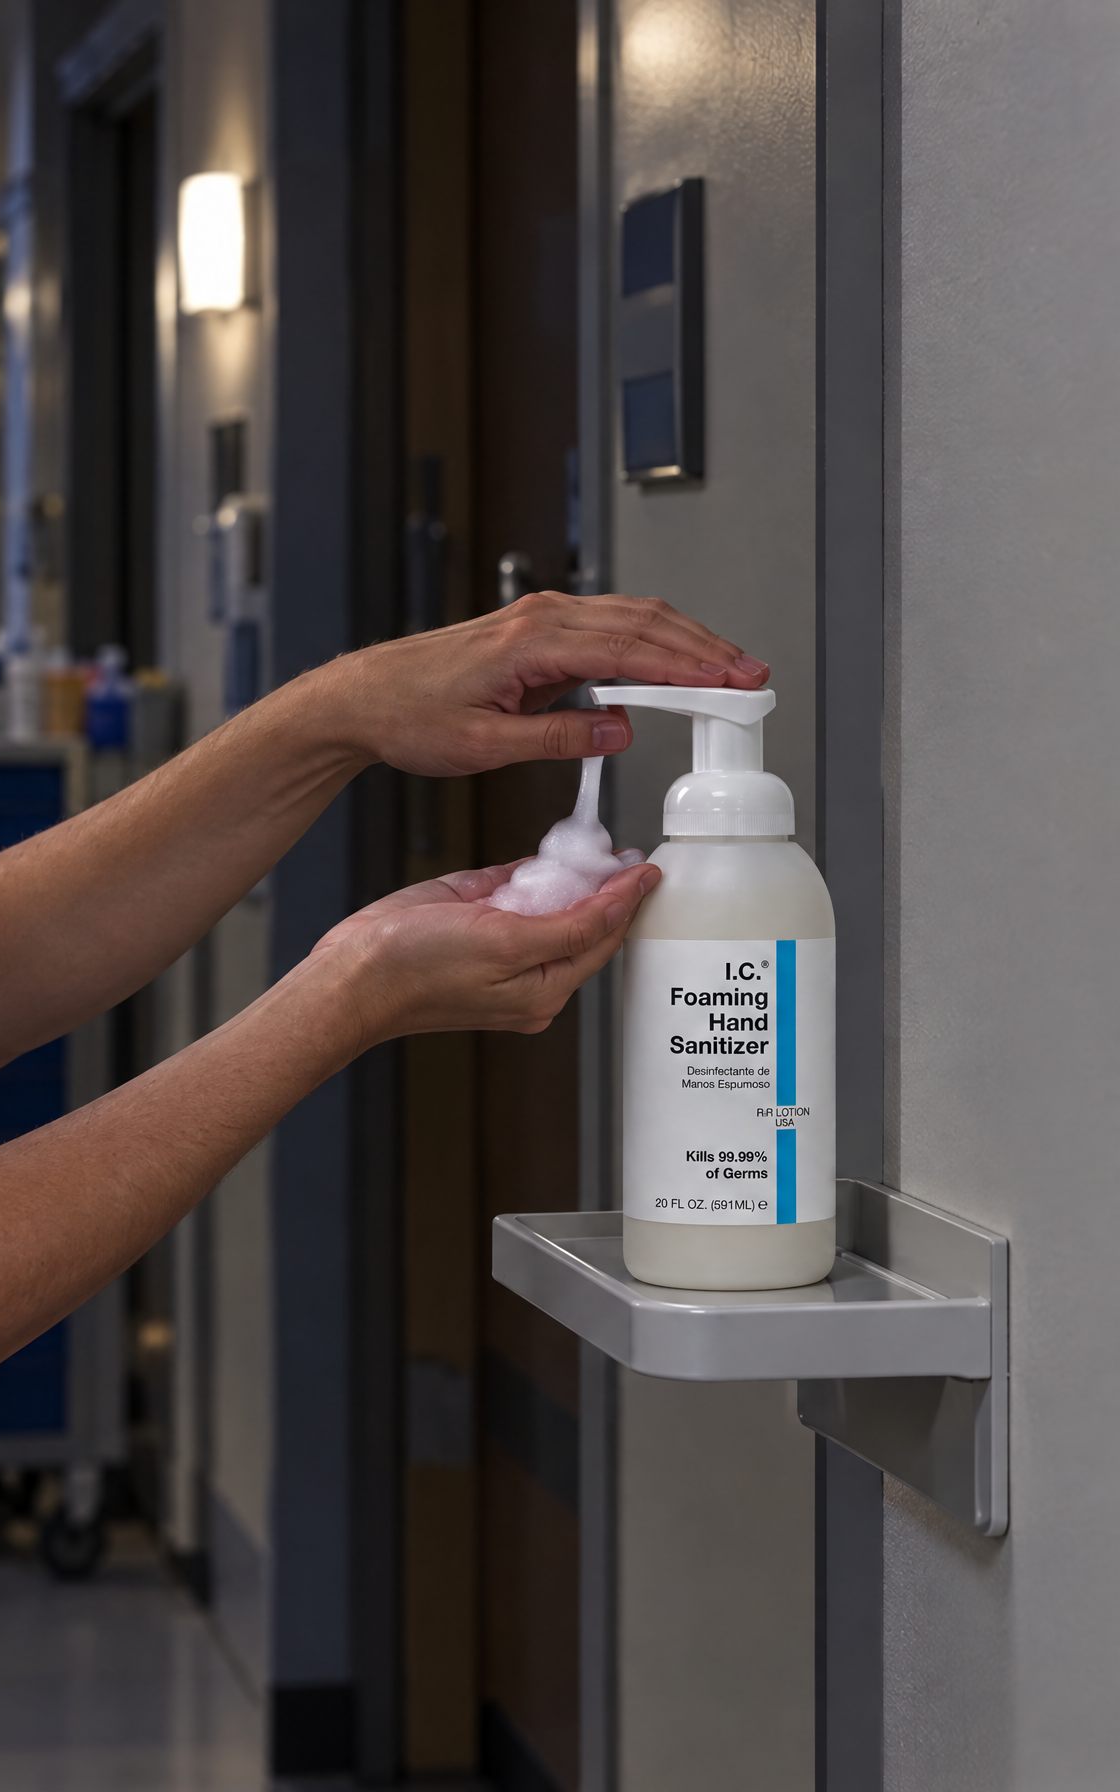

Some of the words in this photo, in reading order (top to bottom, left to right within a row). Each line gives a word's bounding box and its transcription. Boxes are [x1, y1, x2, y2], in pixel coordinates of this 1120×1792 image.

[671, 987, 768, 1010] Foaming
[709, 1013, 768, 1031] Hand
[670, 1035, 769, 1054] Sanitizer
[687, 1066, 754, 1076] Desinfectante
[758, 1066, 770, 1076] de
[682, 1079, 715, 1088] Manos
[718, 1080, 770, 1090] Espumoso
[776, 1107, 810, 1117] LOTION
[776, 1118, 794, 1127] USA
[686, 1151, 714, 1162] Kills
[719, 1151, 767, 1162] 99.99%
[706, 1168, 720, 1179] of
[723, 1168, 768, 1179] Germs
[656, 1198, 668, 1208] 20
[671, 1199, 684, 1209] FL
[688, 1199, 707, 1209] OZ.
[711, 1200, 755, 1212] (591ML)
